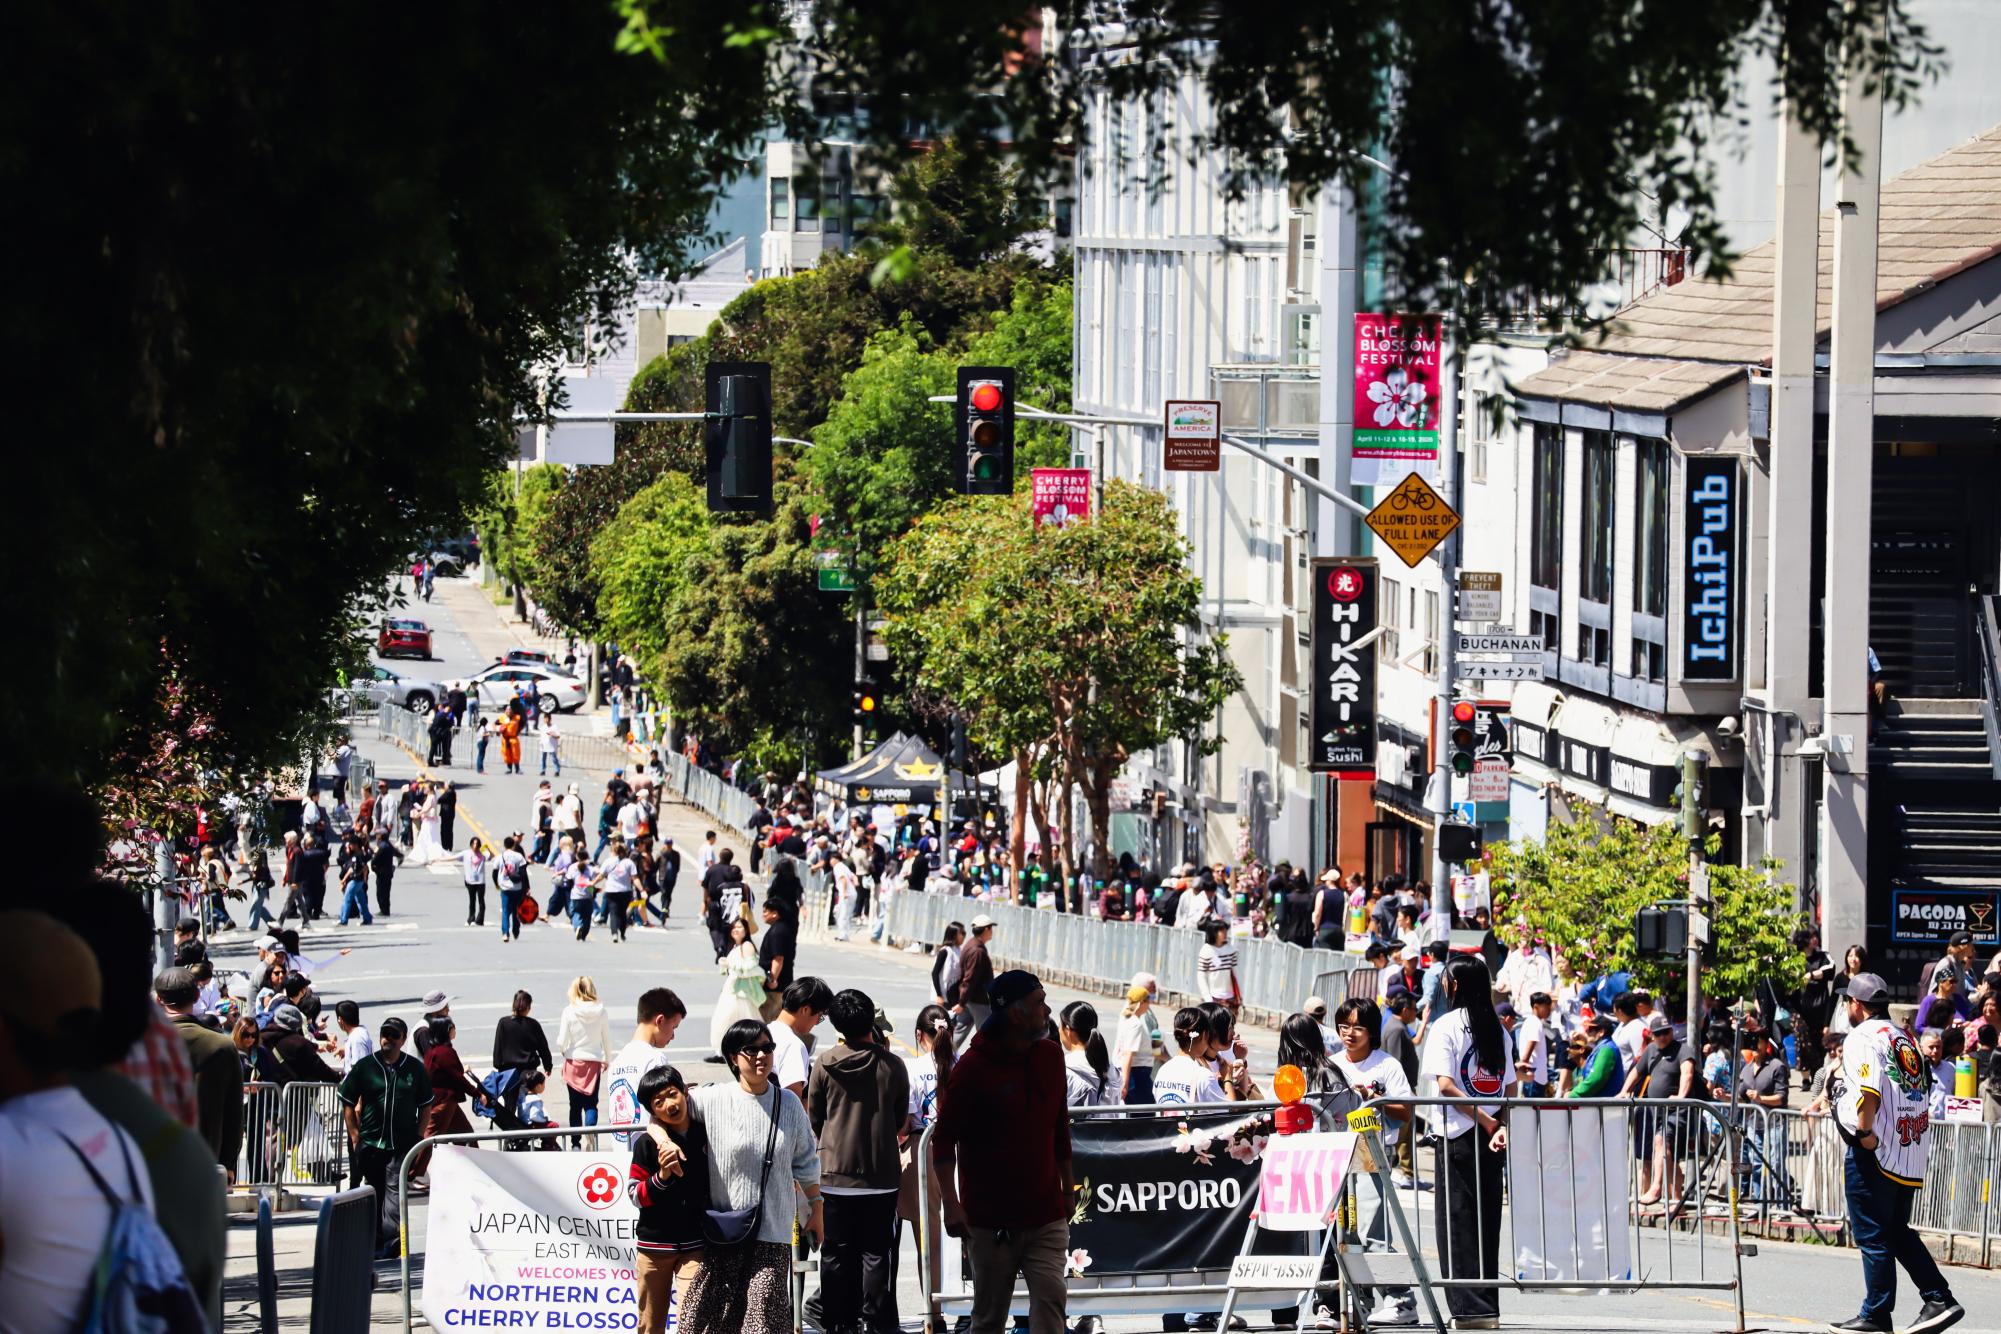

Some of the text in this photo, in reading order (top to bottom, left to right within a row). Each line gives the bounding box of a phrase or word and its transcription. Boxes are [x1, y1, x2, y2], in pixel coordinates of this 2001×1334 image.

[1361, 325, 1424, 338] CHER
[1360, 339, 1436, 352] BLOSSOM
[1360, 353, 1434, 365] FESTIVAL
[1169, 447, 1217, 457] JAPANTOWN
[1036, 476, 1086, 485] CHERRY
[1036, 485, 1086, 494] BLOSSOM
[1036, 495, 1085, 503] FESTIVAL
[1371, 514, 1454, 525] ALLOWED USE OF
[1384, 528, 1440, 540] FULL LANE
[1691, 475, 1728, 661] IchiPub
[1336, 573, 1355, 592] 光
[1464, 574, 1497, 582] PREVENT
[1469, 582, 1491, 590] THEFT
[1461, 638, 1541, 650] BUCHANAN
[1329, 603, 1361, 721] HIKARI
[1327, 751, 1363, 762] Sushi
[1899, 903, 1966, 920] PAGODA
[1927, 921, 1966, 930] 파고다
[1154, 1080, 1191, 1094] VOLUNTEE
[1096, 1177, 1241, 1213] SAPPORO
[470, 1212, 550, 1234] JAPAN
[535, 1242, 577, 1259] EAST
[586, 1246, 621, 1261] AND
[517, 1266, 607, 1280] WELCOMES
[469, 1283, 599, 1304] NORTHERN
[444, 1307, 638, 1330] CHERRY BLOSSO
